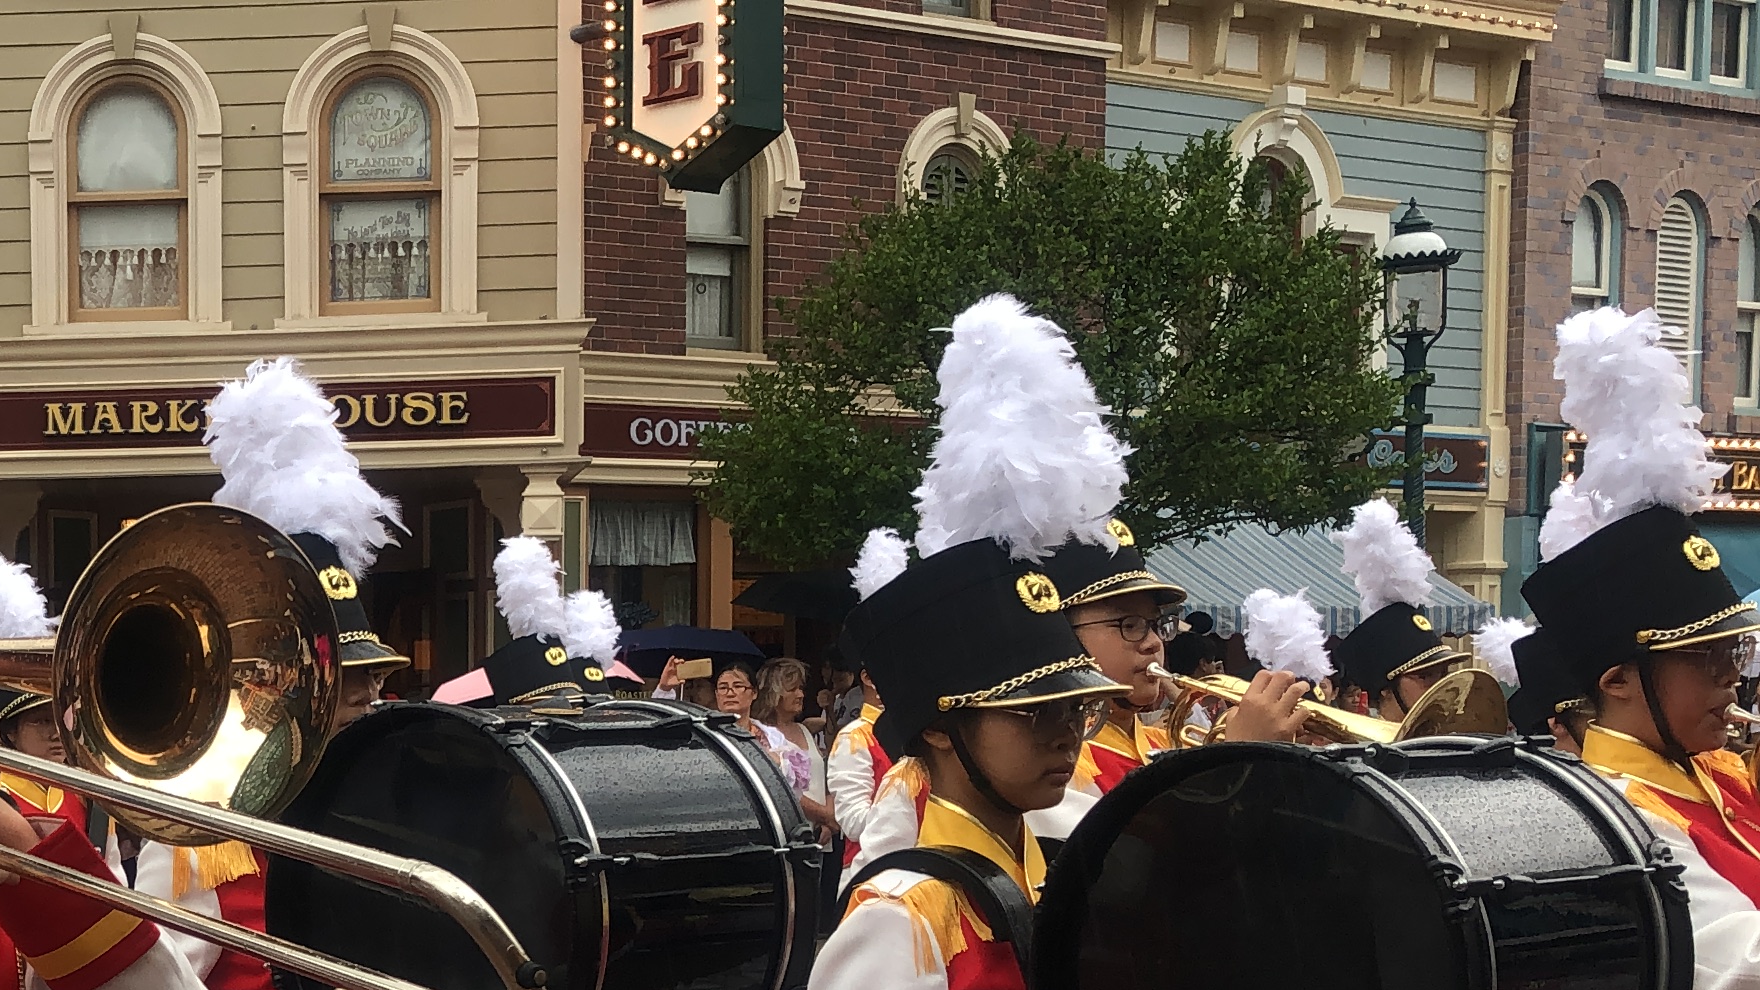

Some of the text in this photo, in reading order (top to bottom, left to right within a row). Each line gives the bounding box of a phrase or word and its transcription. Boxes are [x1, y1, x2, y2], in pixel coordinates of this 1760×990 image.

[642, 0, 703, 107] E
[43, 391, 471, 435] MARK OUSE
